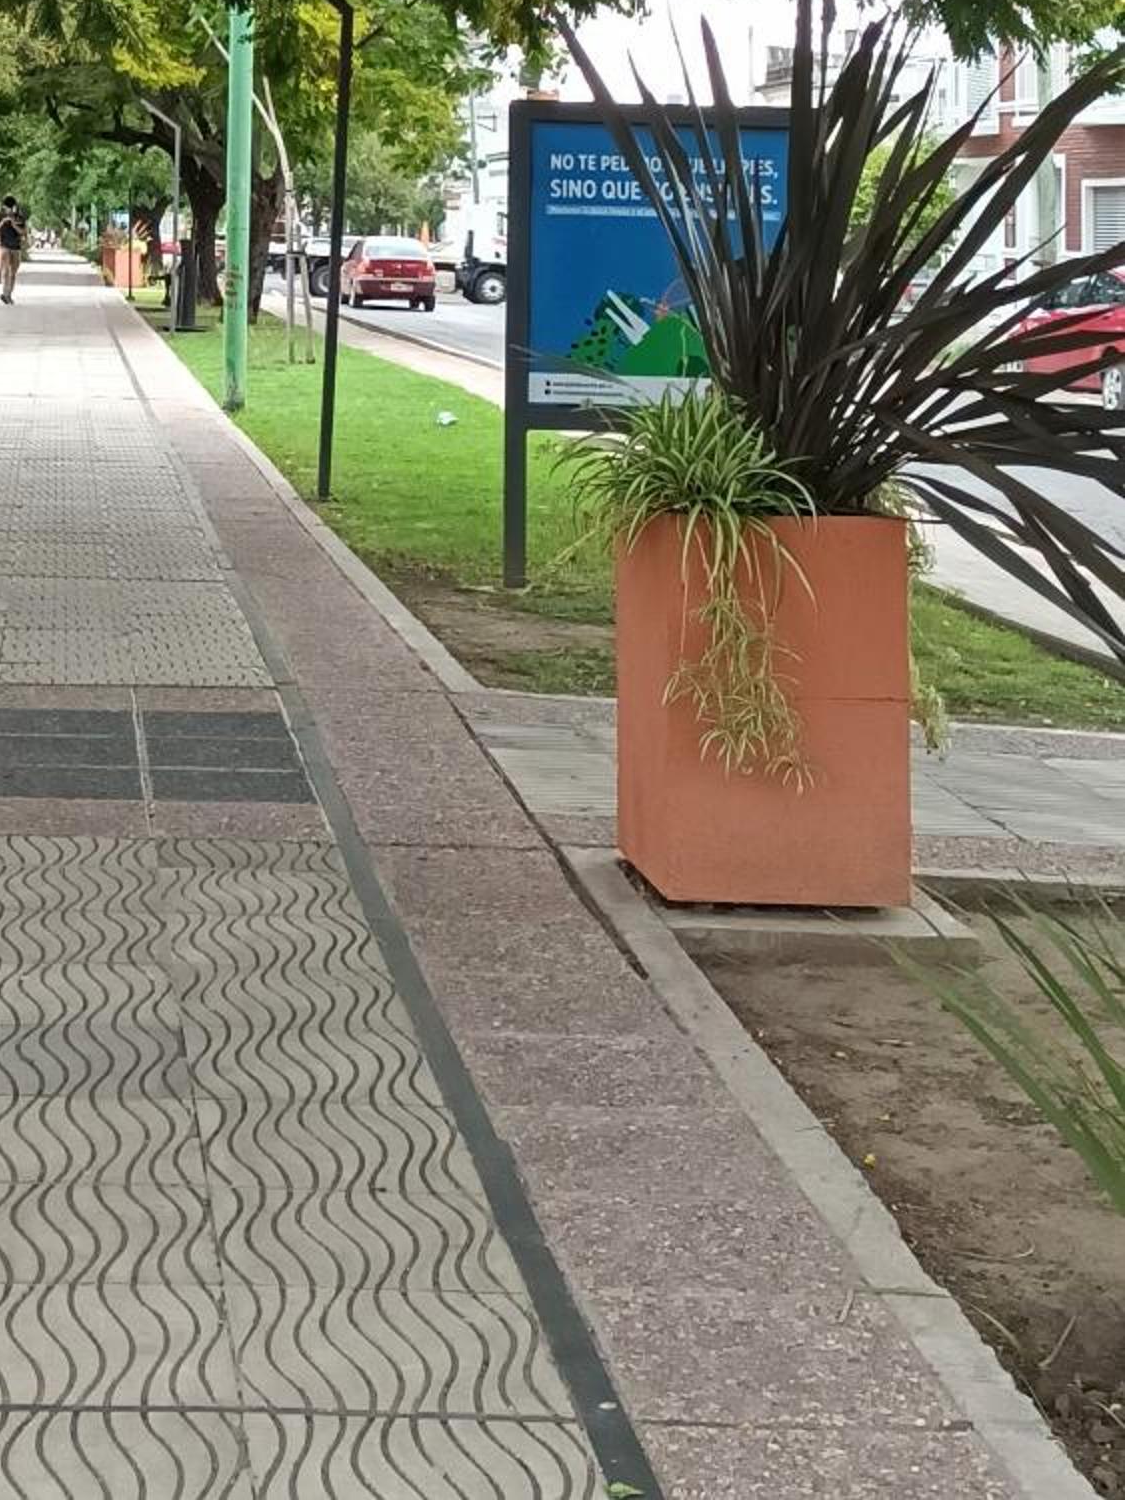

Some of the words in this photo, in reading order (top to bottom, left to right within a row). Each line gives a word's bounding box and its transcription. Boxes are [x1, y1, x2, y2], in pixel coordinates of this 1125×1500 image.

[550, 153, 574, 171] NO
[578, 154, 597, 171] TE
[550, 179, 596, 199] SINO
[602, 181, 642, 200] QUE
